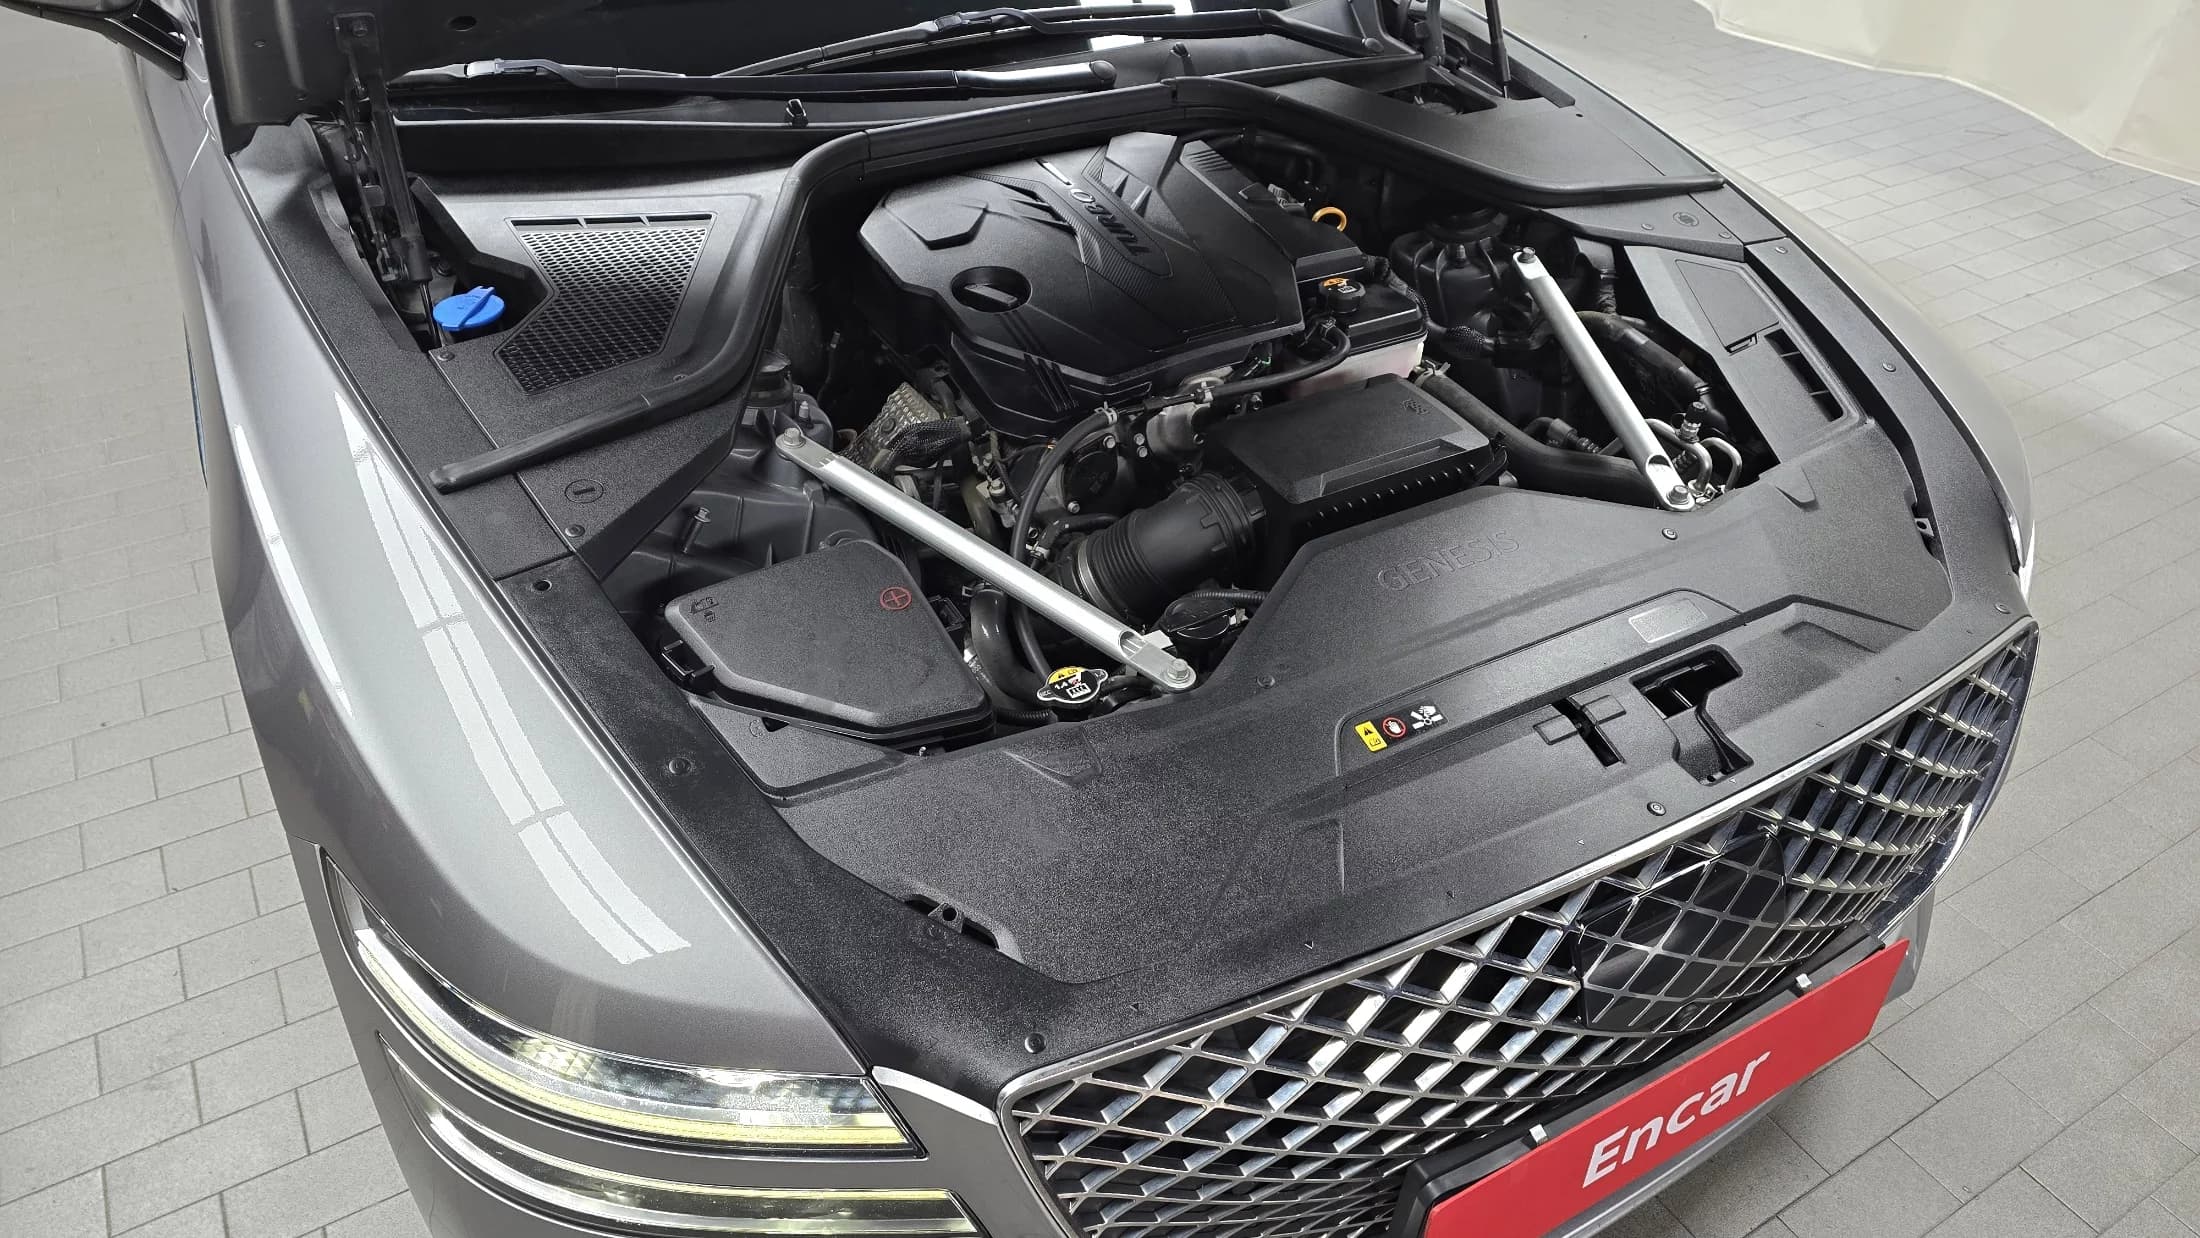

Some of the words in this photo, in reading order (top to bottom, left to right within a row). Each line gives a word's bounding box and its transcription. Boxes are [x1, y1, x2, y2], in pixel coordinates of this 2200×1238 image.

[1070, 188, 1152, 257] TURBO
[1377, 530, 1520, 591] GENESIS
[1582, 1051, 1772, 1189] Encar
